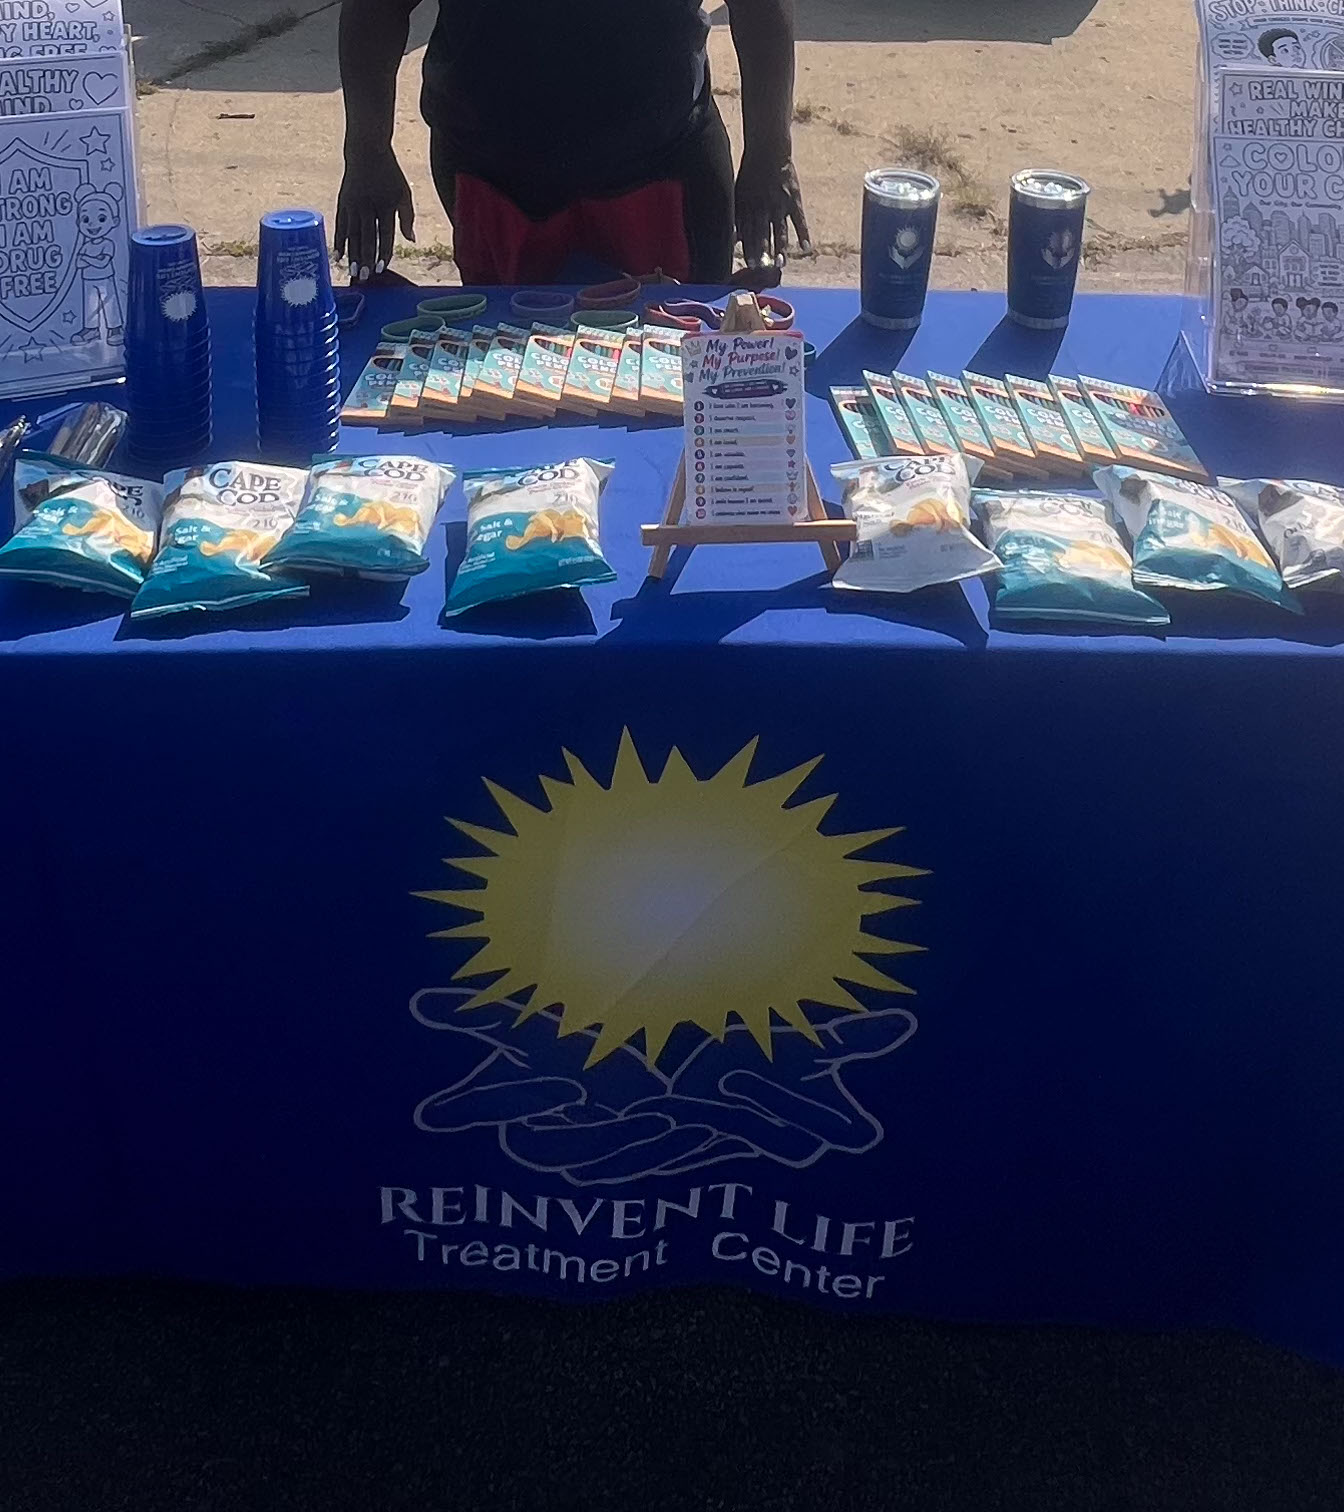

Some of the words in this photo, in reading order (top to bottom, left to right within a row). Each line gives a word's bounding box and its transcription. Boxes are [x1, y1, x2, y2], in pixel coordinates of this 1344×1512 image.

[22, 20, 101, 43] HEART,
[1248, 79, 1299, 101] REAL
[1227, 118, 1317, 138] HEALTHY
[8, 167, 52, 194] AM
[1232, 170, 1318, 200] YOUR
[12, 221, 54, 246] AM
[0, 272, 58, 299] FREE
[706, 339, 727, 356] My
[702, 354, 722, 370] My
[699, 368, 718, 384] My
[358, 458, 429, 474] CAPE
[363, 467, 426, 482] COD
[208, 467, 282, 491] CAPE
[517, 468, 580, 487] COD
[216, 489, 280, 506] COD
[175, 525, 200, 535] Salt
[480, 519, 503, 532] Salt
[380, 1182, 753, 1239] REINVENT
[772, 1199, 917, 1259] LIFE
[403, 1229, 669, 1284] Treatment
[711, 1231, 886, 1300] Center
